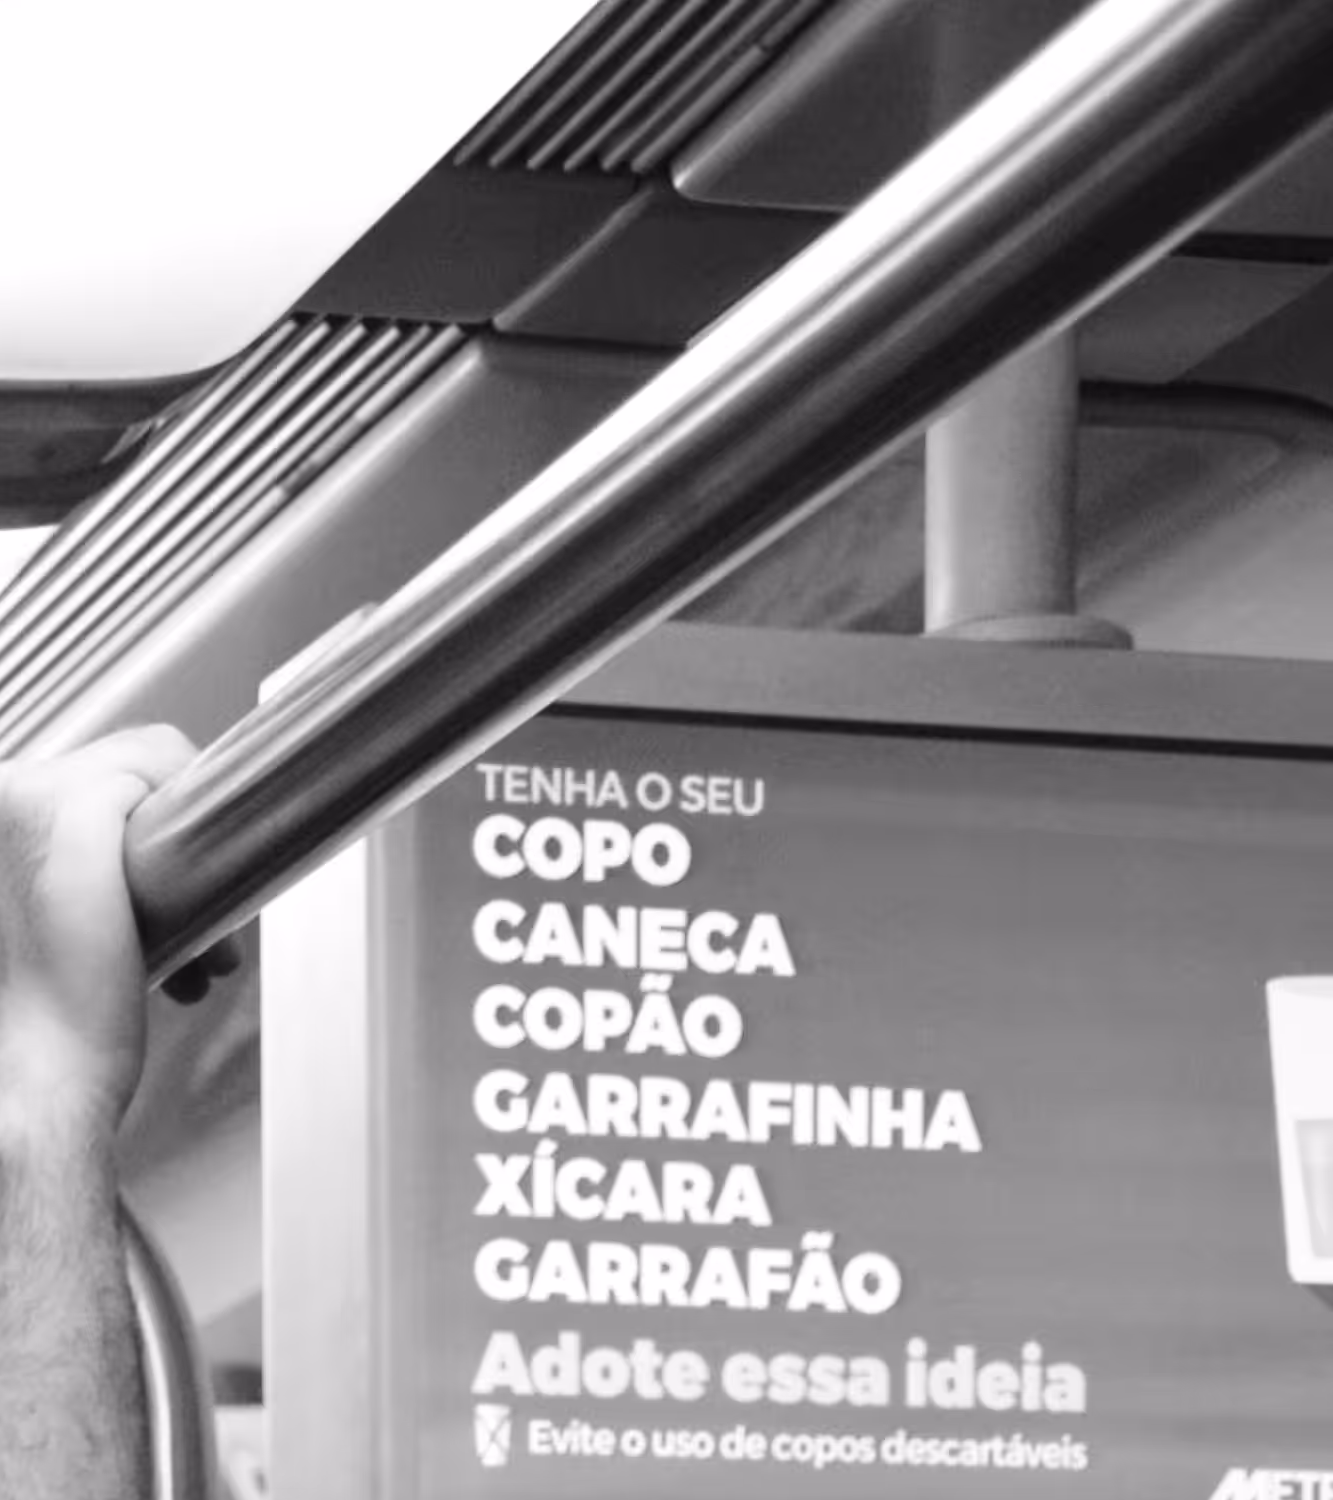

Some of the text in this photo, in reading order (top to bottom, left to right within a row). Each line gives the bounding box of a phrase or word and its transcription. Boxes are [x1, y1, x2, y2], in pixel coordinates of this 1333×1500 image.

[476, 762, 765, 817] TENHA O SEU
[472, 813, 693, 886] COPO
[471, 899, 796, 977] CANECA
[472, 973, 743, 1057] COPÃO
[473, 1069, 982, 1153] GARRAFINHA
[474, 1140, 773, 1226] XÍCARA
[474, 1231, 901, 1315] GARRAFÃO
[472, 1331, 1087, 1413] Adote essa ideia
[528, 1420, 1089, 1470] Evite o uso de copos descartáveis
